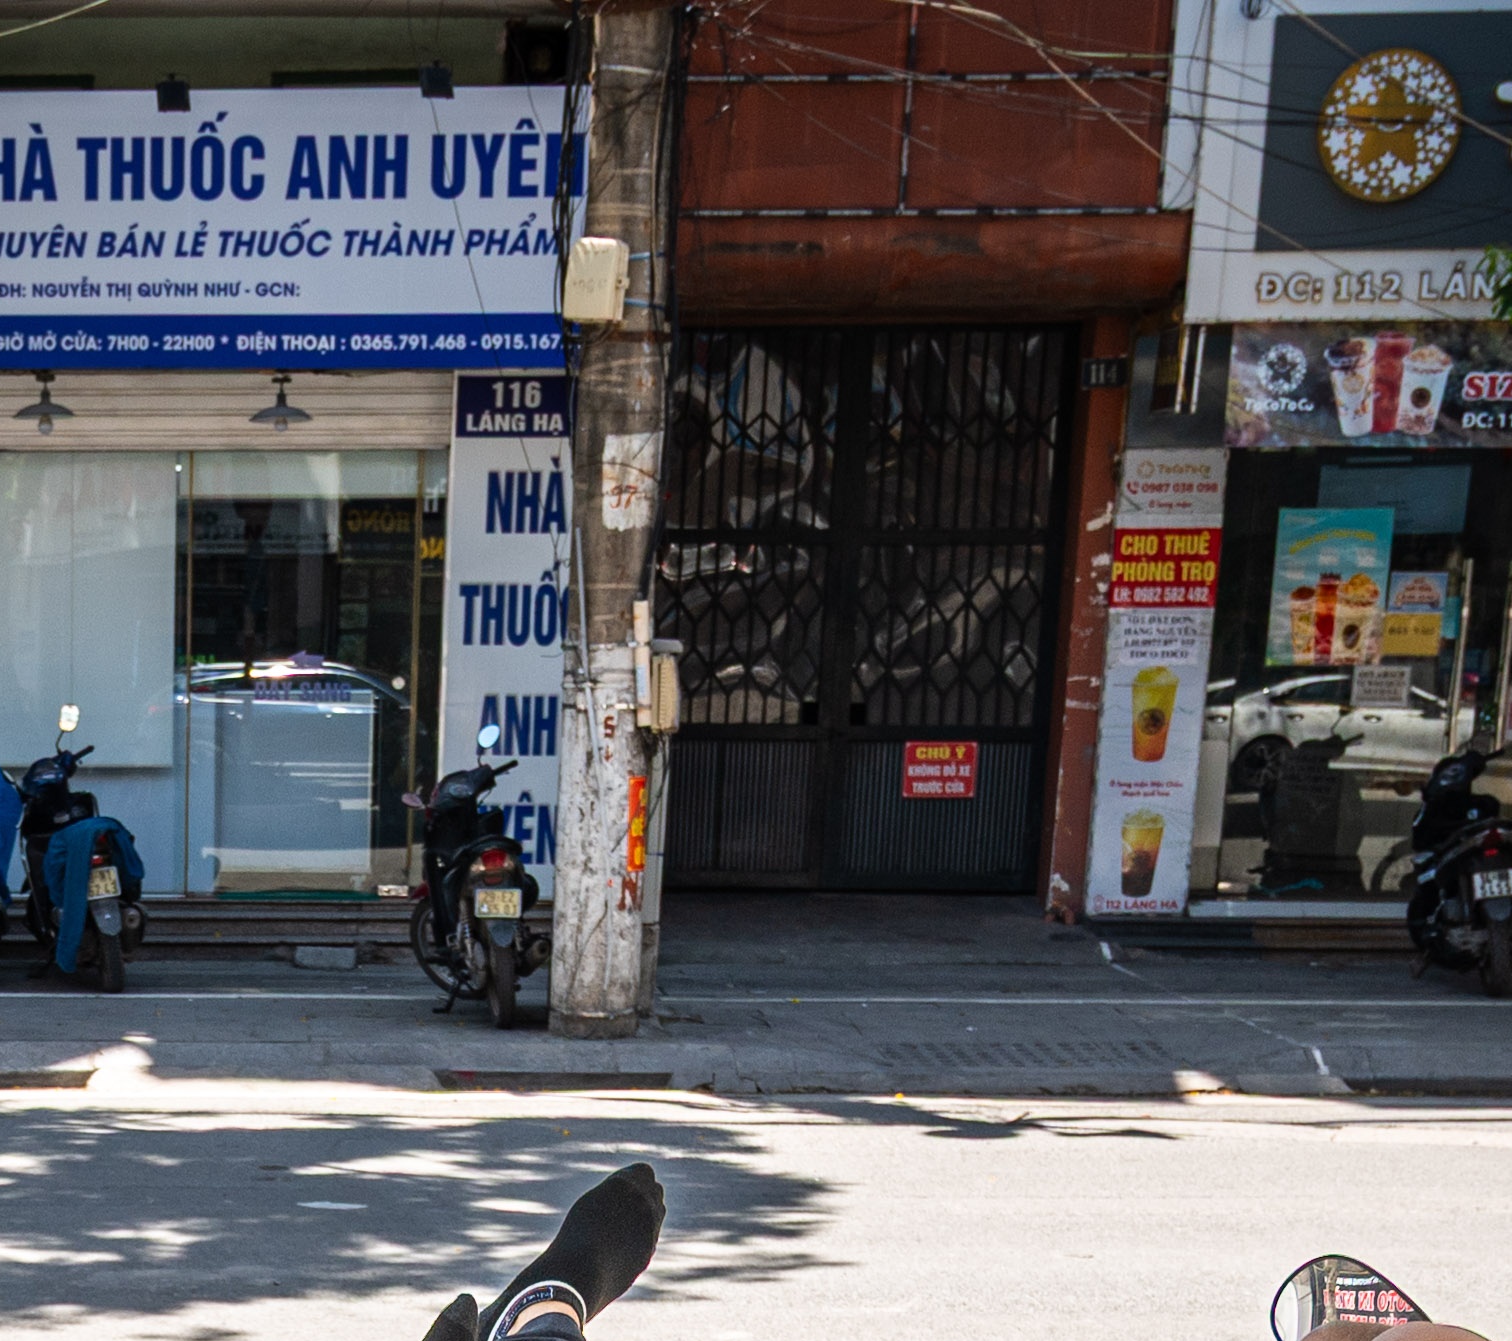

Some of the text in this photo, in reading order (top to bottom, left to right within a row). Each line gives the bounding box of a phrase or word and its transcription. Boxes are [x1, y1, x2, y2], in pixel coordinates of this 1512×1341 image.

[77, 111, 265, 202] THUỐC
[286, 133, 410, 201] ANH
[97, 222, 168, 259] BÁN
[175, 220, 212, 258] LẺ
[217, 218, 333, 258] THUỐC
[342, 217, 455, 257] THÀNH
[462, 211, 563, 257] PHẨM
[31, 276, 101, 299] NGUYỄN
[106, 282, 133, 302] THỊ
[137, 277, 198, 300] QUỲNH
[203, 280, 242, 298] NHƯ
[255, 280, 302, 298] GCN:
[1256, 271, 1403, 303] ĐC: 112
[28, 330, 58, 352] MỞ
[61, 330, 103, 352] CỬA:
[107, 334, 149, 352] 7H00
[163, 335, 216, 352] 22H00
[236, 331, 278, 356] ĐIỆN
[281, 334, 337, 356] THOẠI
[492, 381, 542, 409] 116
[465, 409, 565, 437] LÁNG HẠ
[486, 456, 568, 535] NHÀ
[1120, 530, 1211, 556] CHO THUÊ
[1112, 557, 1216, 586] PHÒNG TRỌ
